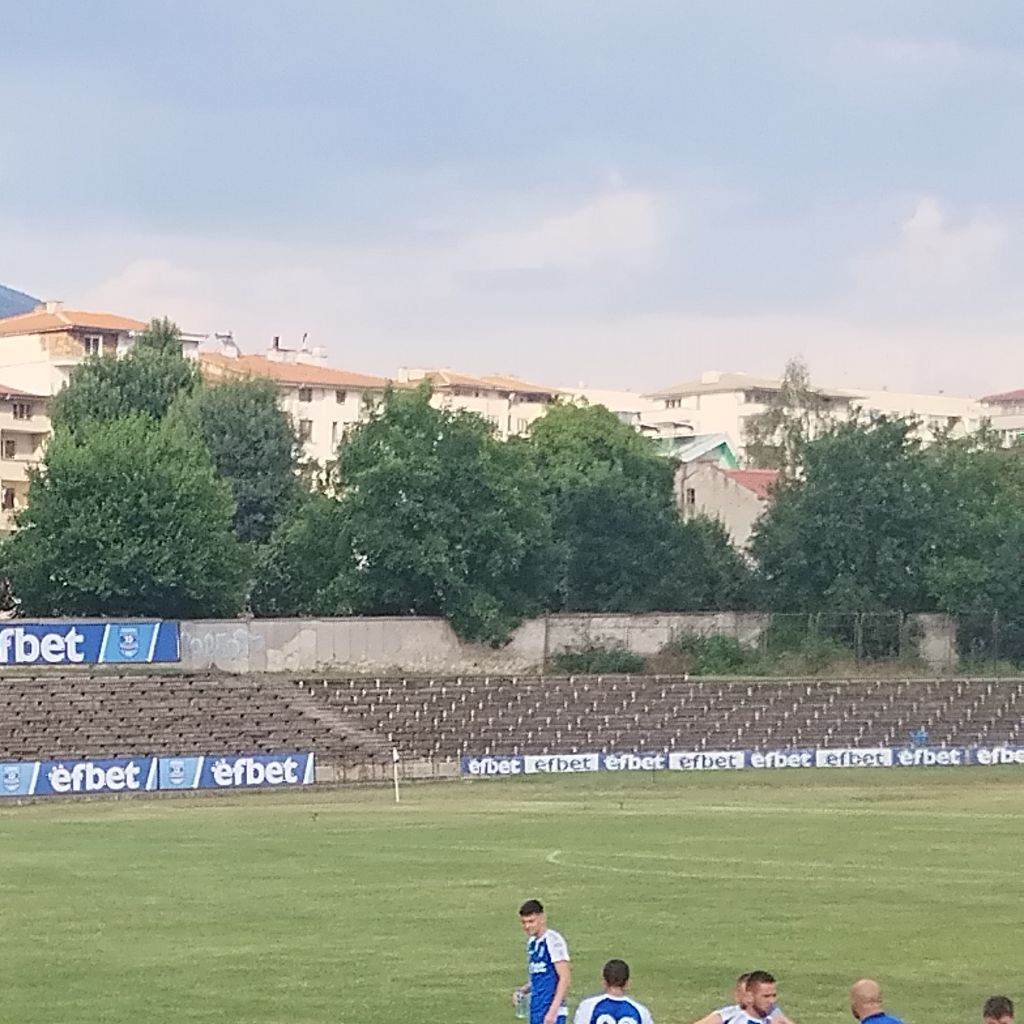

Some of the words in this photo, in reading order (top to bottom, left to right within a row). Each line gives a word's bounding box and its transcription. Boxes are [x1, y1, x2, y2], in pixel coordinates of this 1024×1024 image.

[535, 757, 592, 771] efbet
[605, 753, 665, 770] efbet
[679, 753, 737, 769] efbet
[751, 750, 812, 768] efbet
[826, 750, 884, 766] efbet
[898, 749, 961, 766] efbet
[977, 748, 1024, 765] efbe
[213, 756, 298, 785] efbet
[469, 757, 521, 774] efbet
[50, 761, 140, 792] efbet
